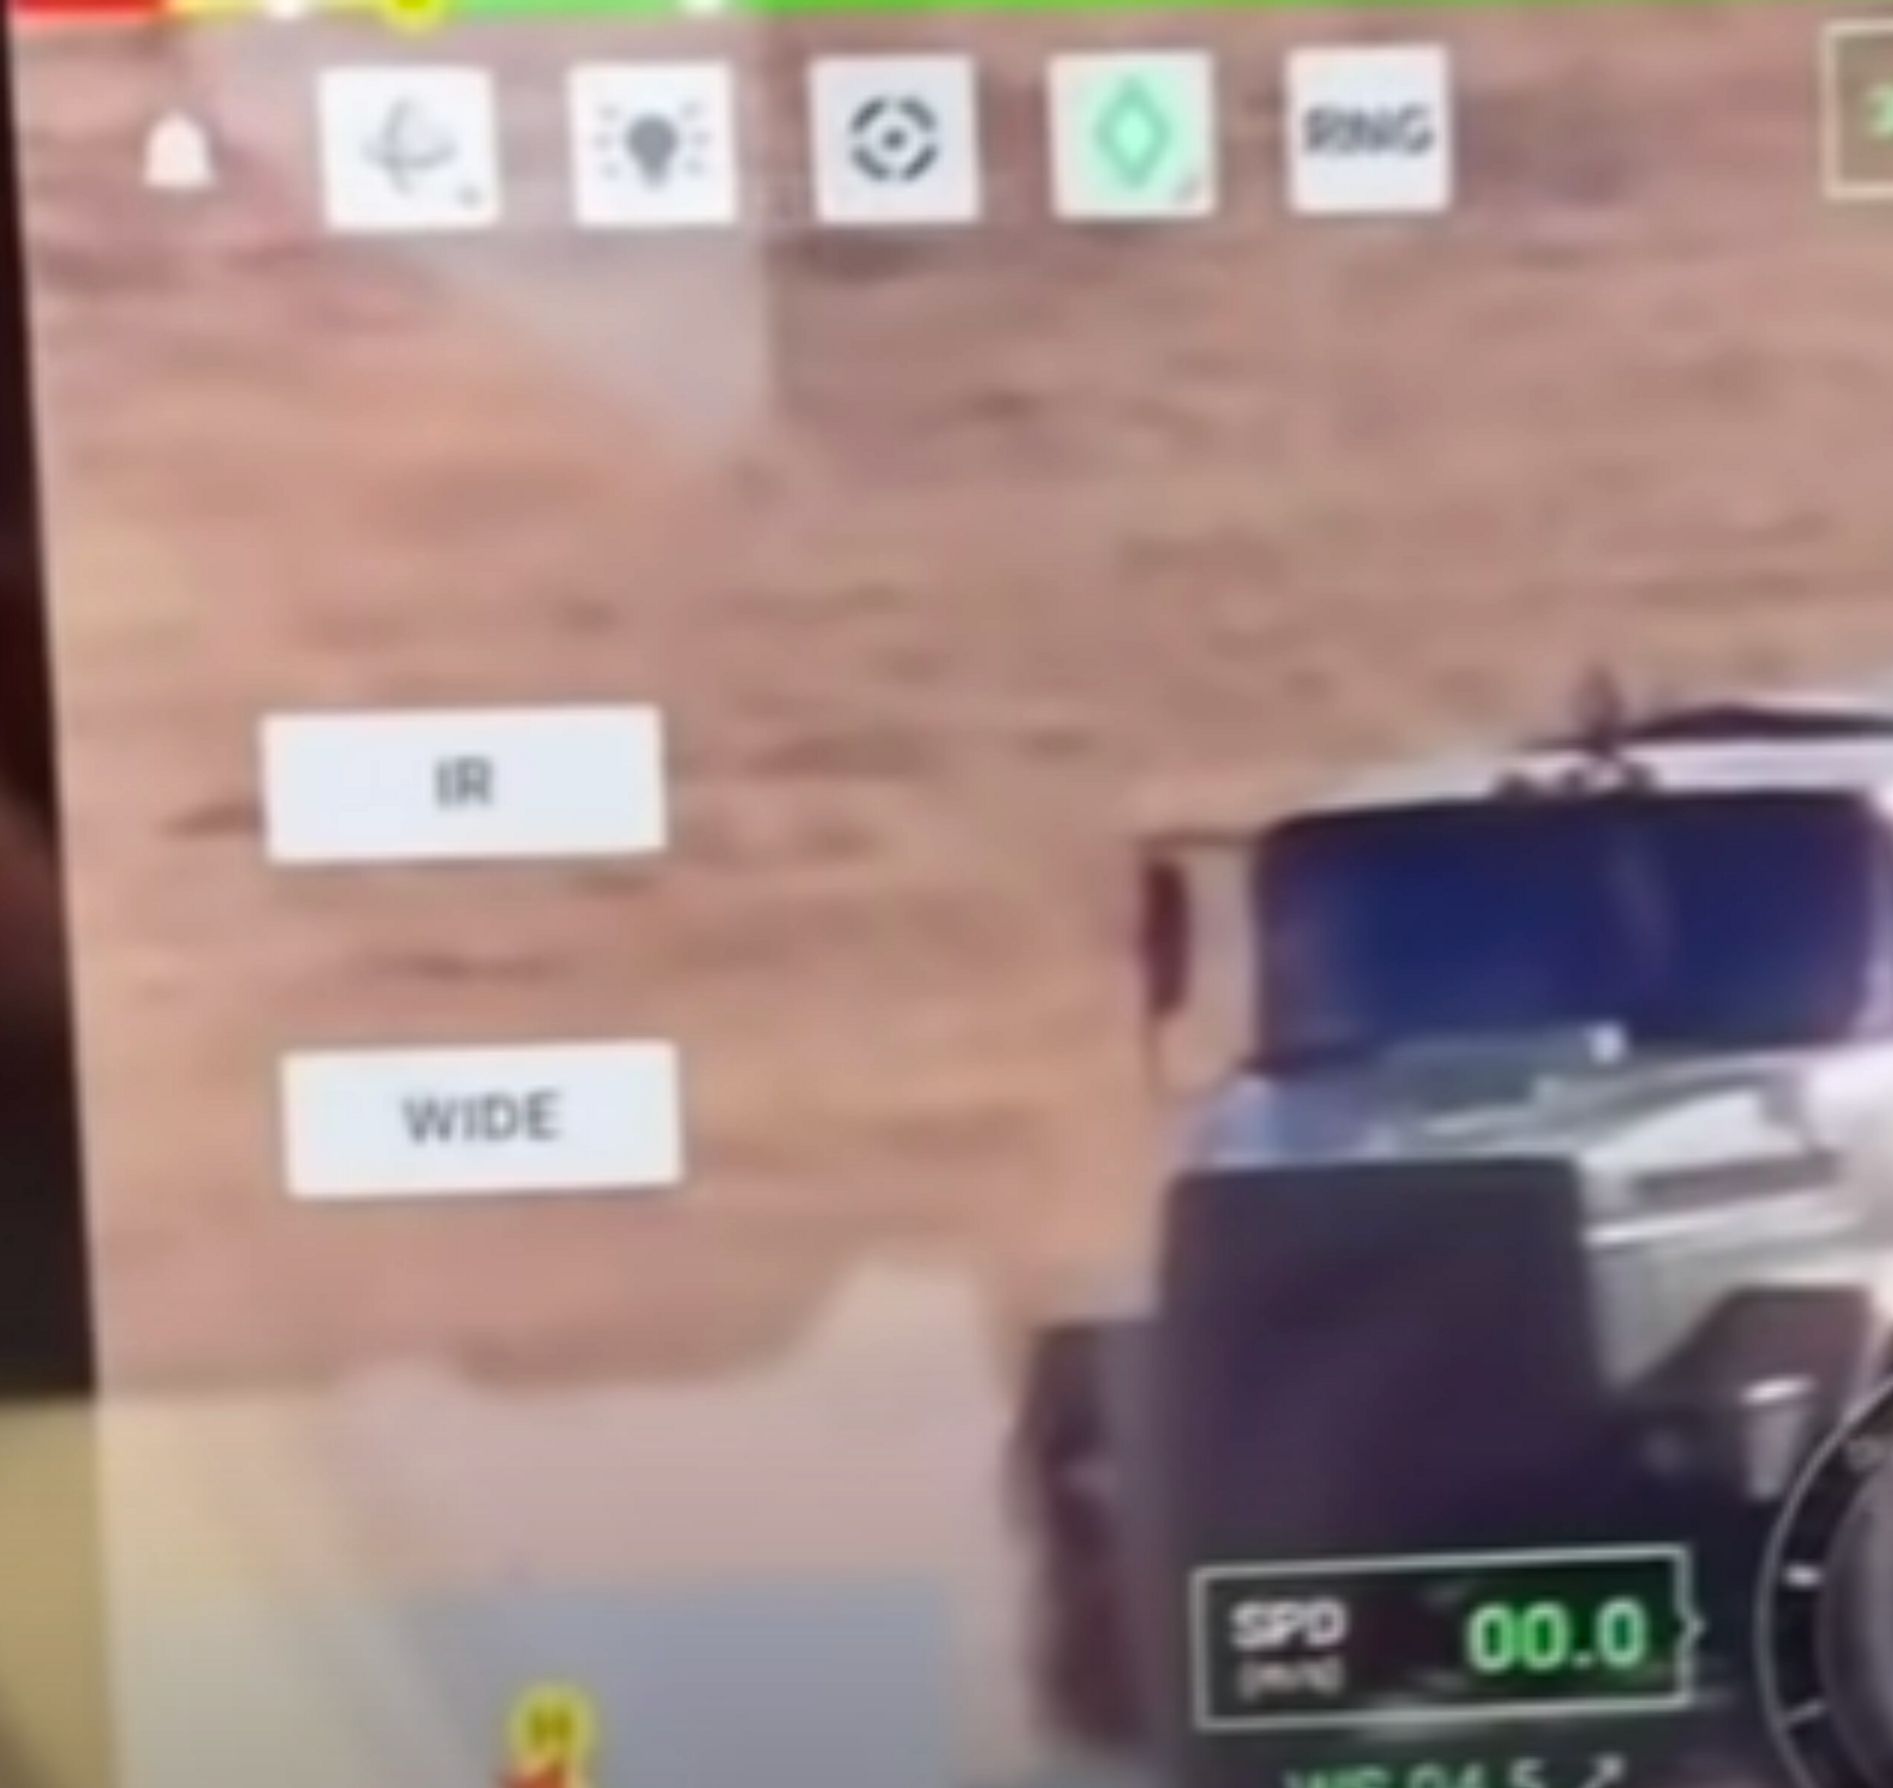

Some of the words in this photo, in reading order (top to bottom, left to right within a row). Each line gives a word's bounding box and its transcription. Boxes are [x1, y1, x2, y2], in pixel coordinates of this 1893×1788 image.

[434, 756, 494, 807] IR
[403, 1090, 564, 1144] WIDE
[1230, 1597, 1347, 1653] SPD
[1466, 1598, 1646, 1673] 00.0
